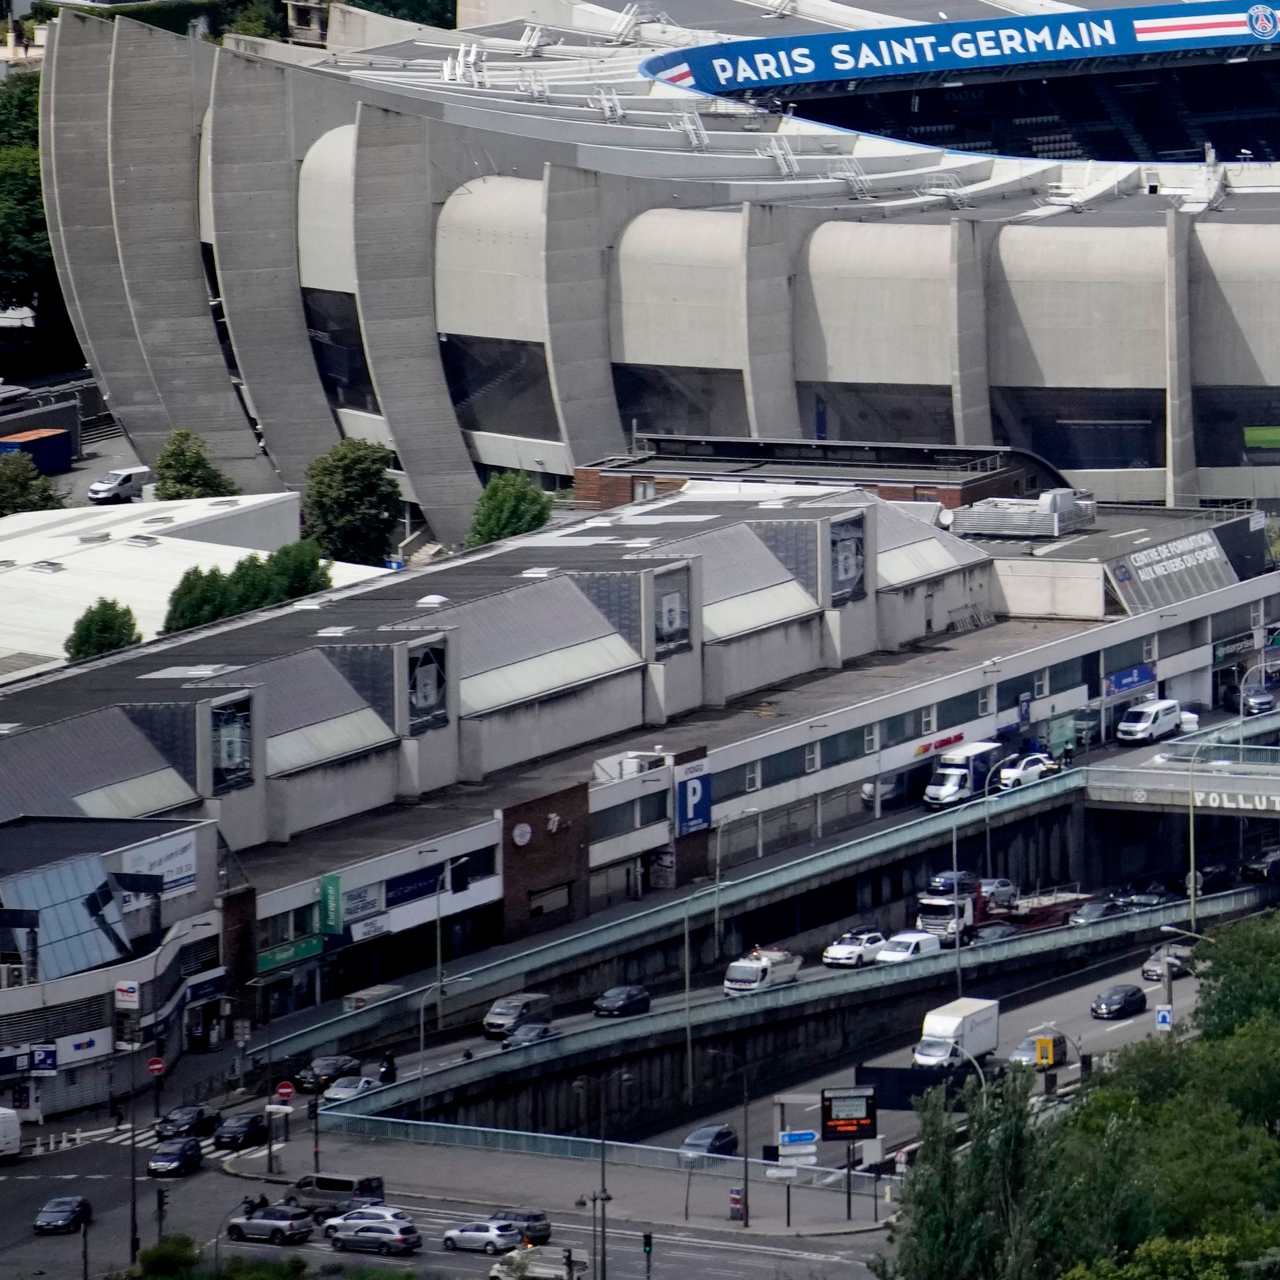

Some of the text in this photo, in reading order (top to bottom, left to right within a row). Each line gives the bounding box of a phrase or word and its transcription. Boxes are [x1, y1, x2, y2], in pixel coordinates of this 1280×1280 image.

[712, 20, 1117, 85] PARIS SAINT-GERMAIN
[1130, 532, 1213, 567] CENTRE DE FORMATION
[1137, 566, 1157, 582] AUX
[1183, 553, 1198, 567] DU
[1194, 546, 1220, 565] SPORT
[686, 779, 702, 819] P
[327, 886, 335, 925] Europcar
[34, 1051, 45, 1065] P
